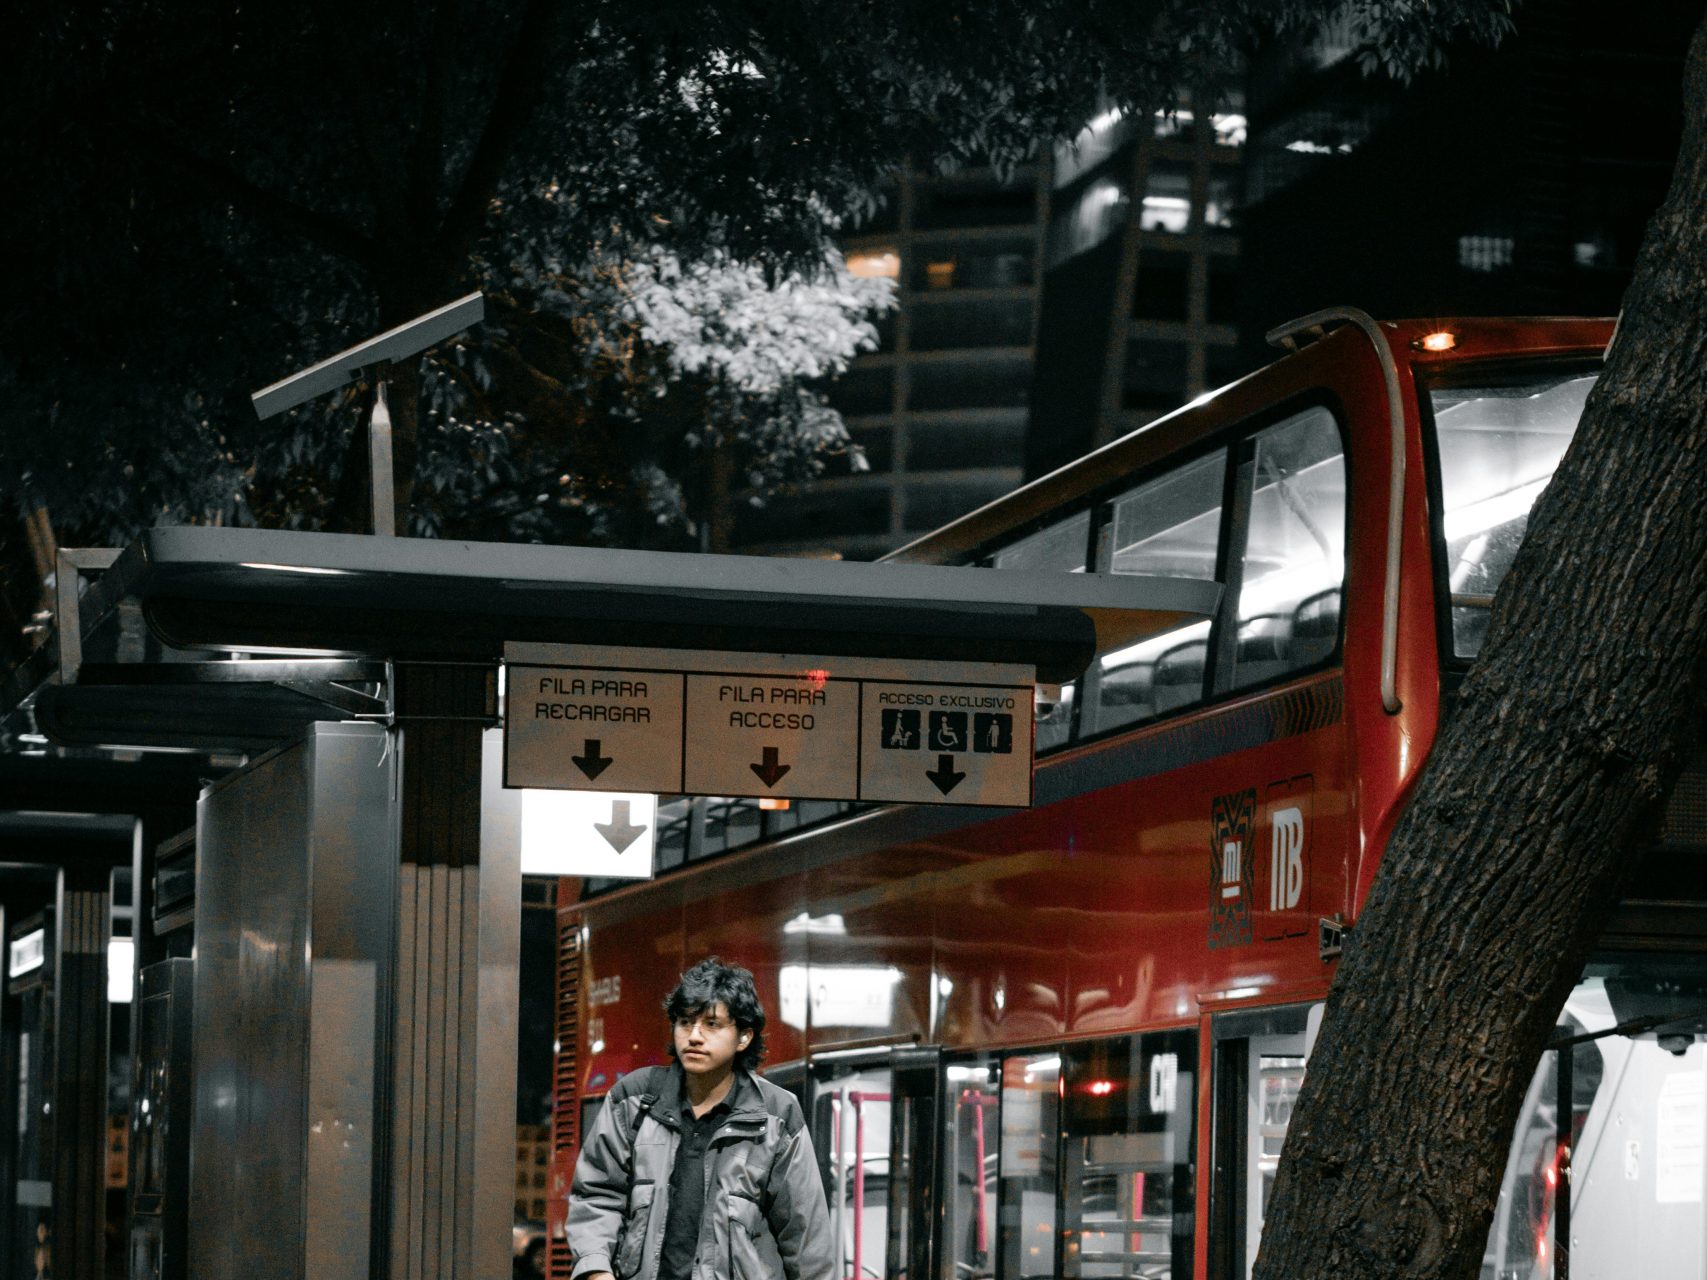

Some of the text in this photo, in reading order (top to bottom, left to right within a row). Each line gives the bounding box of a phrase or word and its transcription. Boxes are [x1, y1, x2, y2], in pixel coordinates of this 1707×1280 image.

[540, 678, 648, 698] FILA PARA
[719, 685, 826, 705] FILA PARA
[879, 692, 1016, 709] ACCESO EXCLUSIVO
[535, 703, 651, 723] RECARGAR
[729, 712, 815, 730] ACCESO
